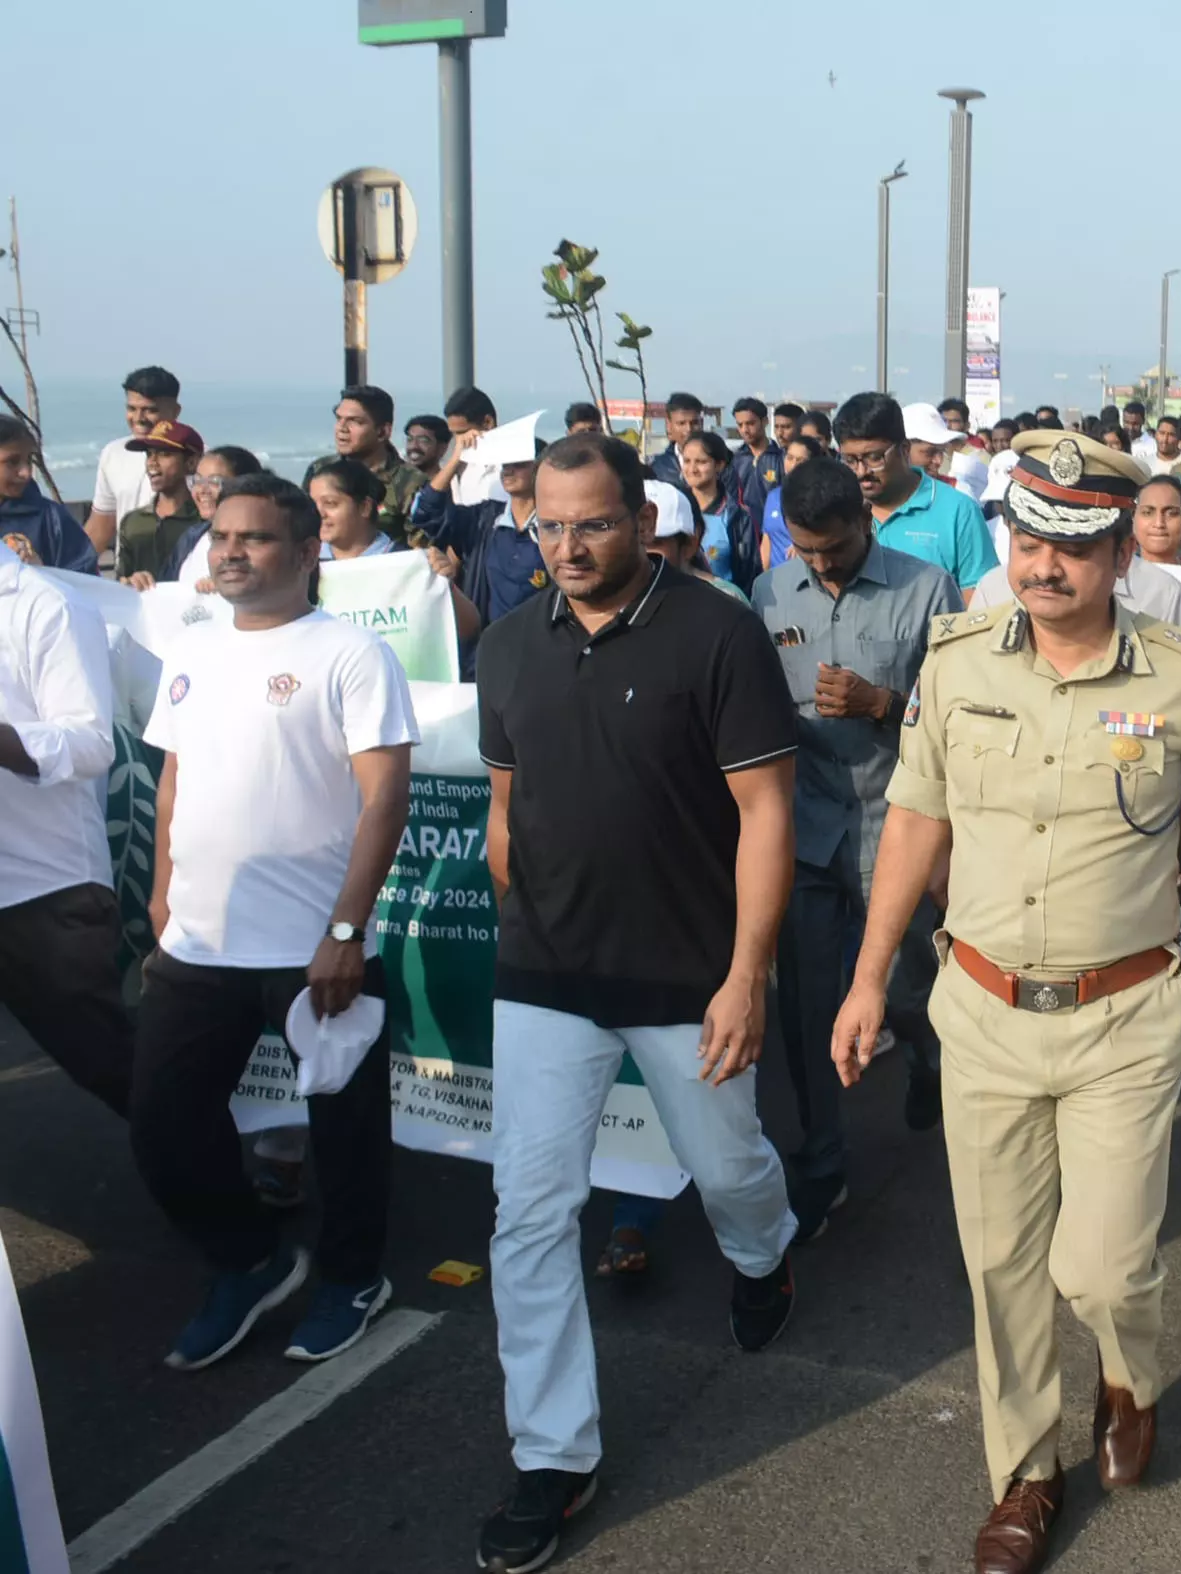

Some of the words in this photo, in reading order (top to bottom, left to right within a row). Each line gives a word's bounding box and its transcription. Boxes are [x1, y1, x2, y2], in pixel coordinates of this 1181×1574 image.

[422, 801, 460, 819] India
[410, 885, 440, 911] Day
[443, 888, 491, 909] 2024
[408, 919, 464, 940] Bharat
[467, 924, 490, 941] ho
[601, 1114, 620, 1129] CT
